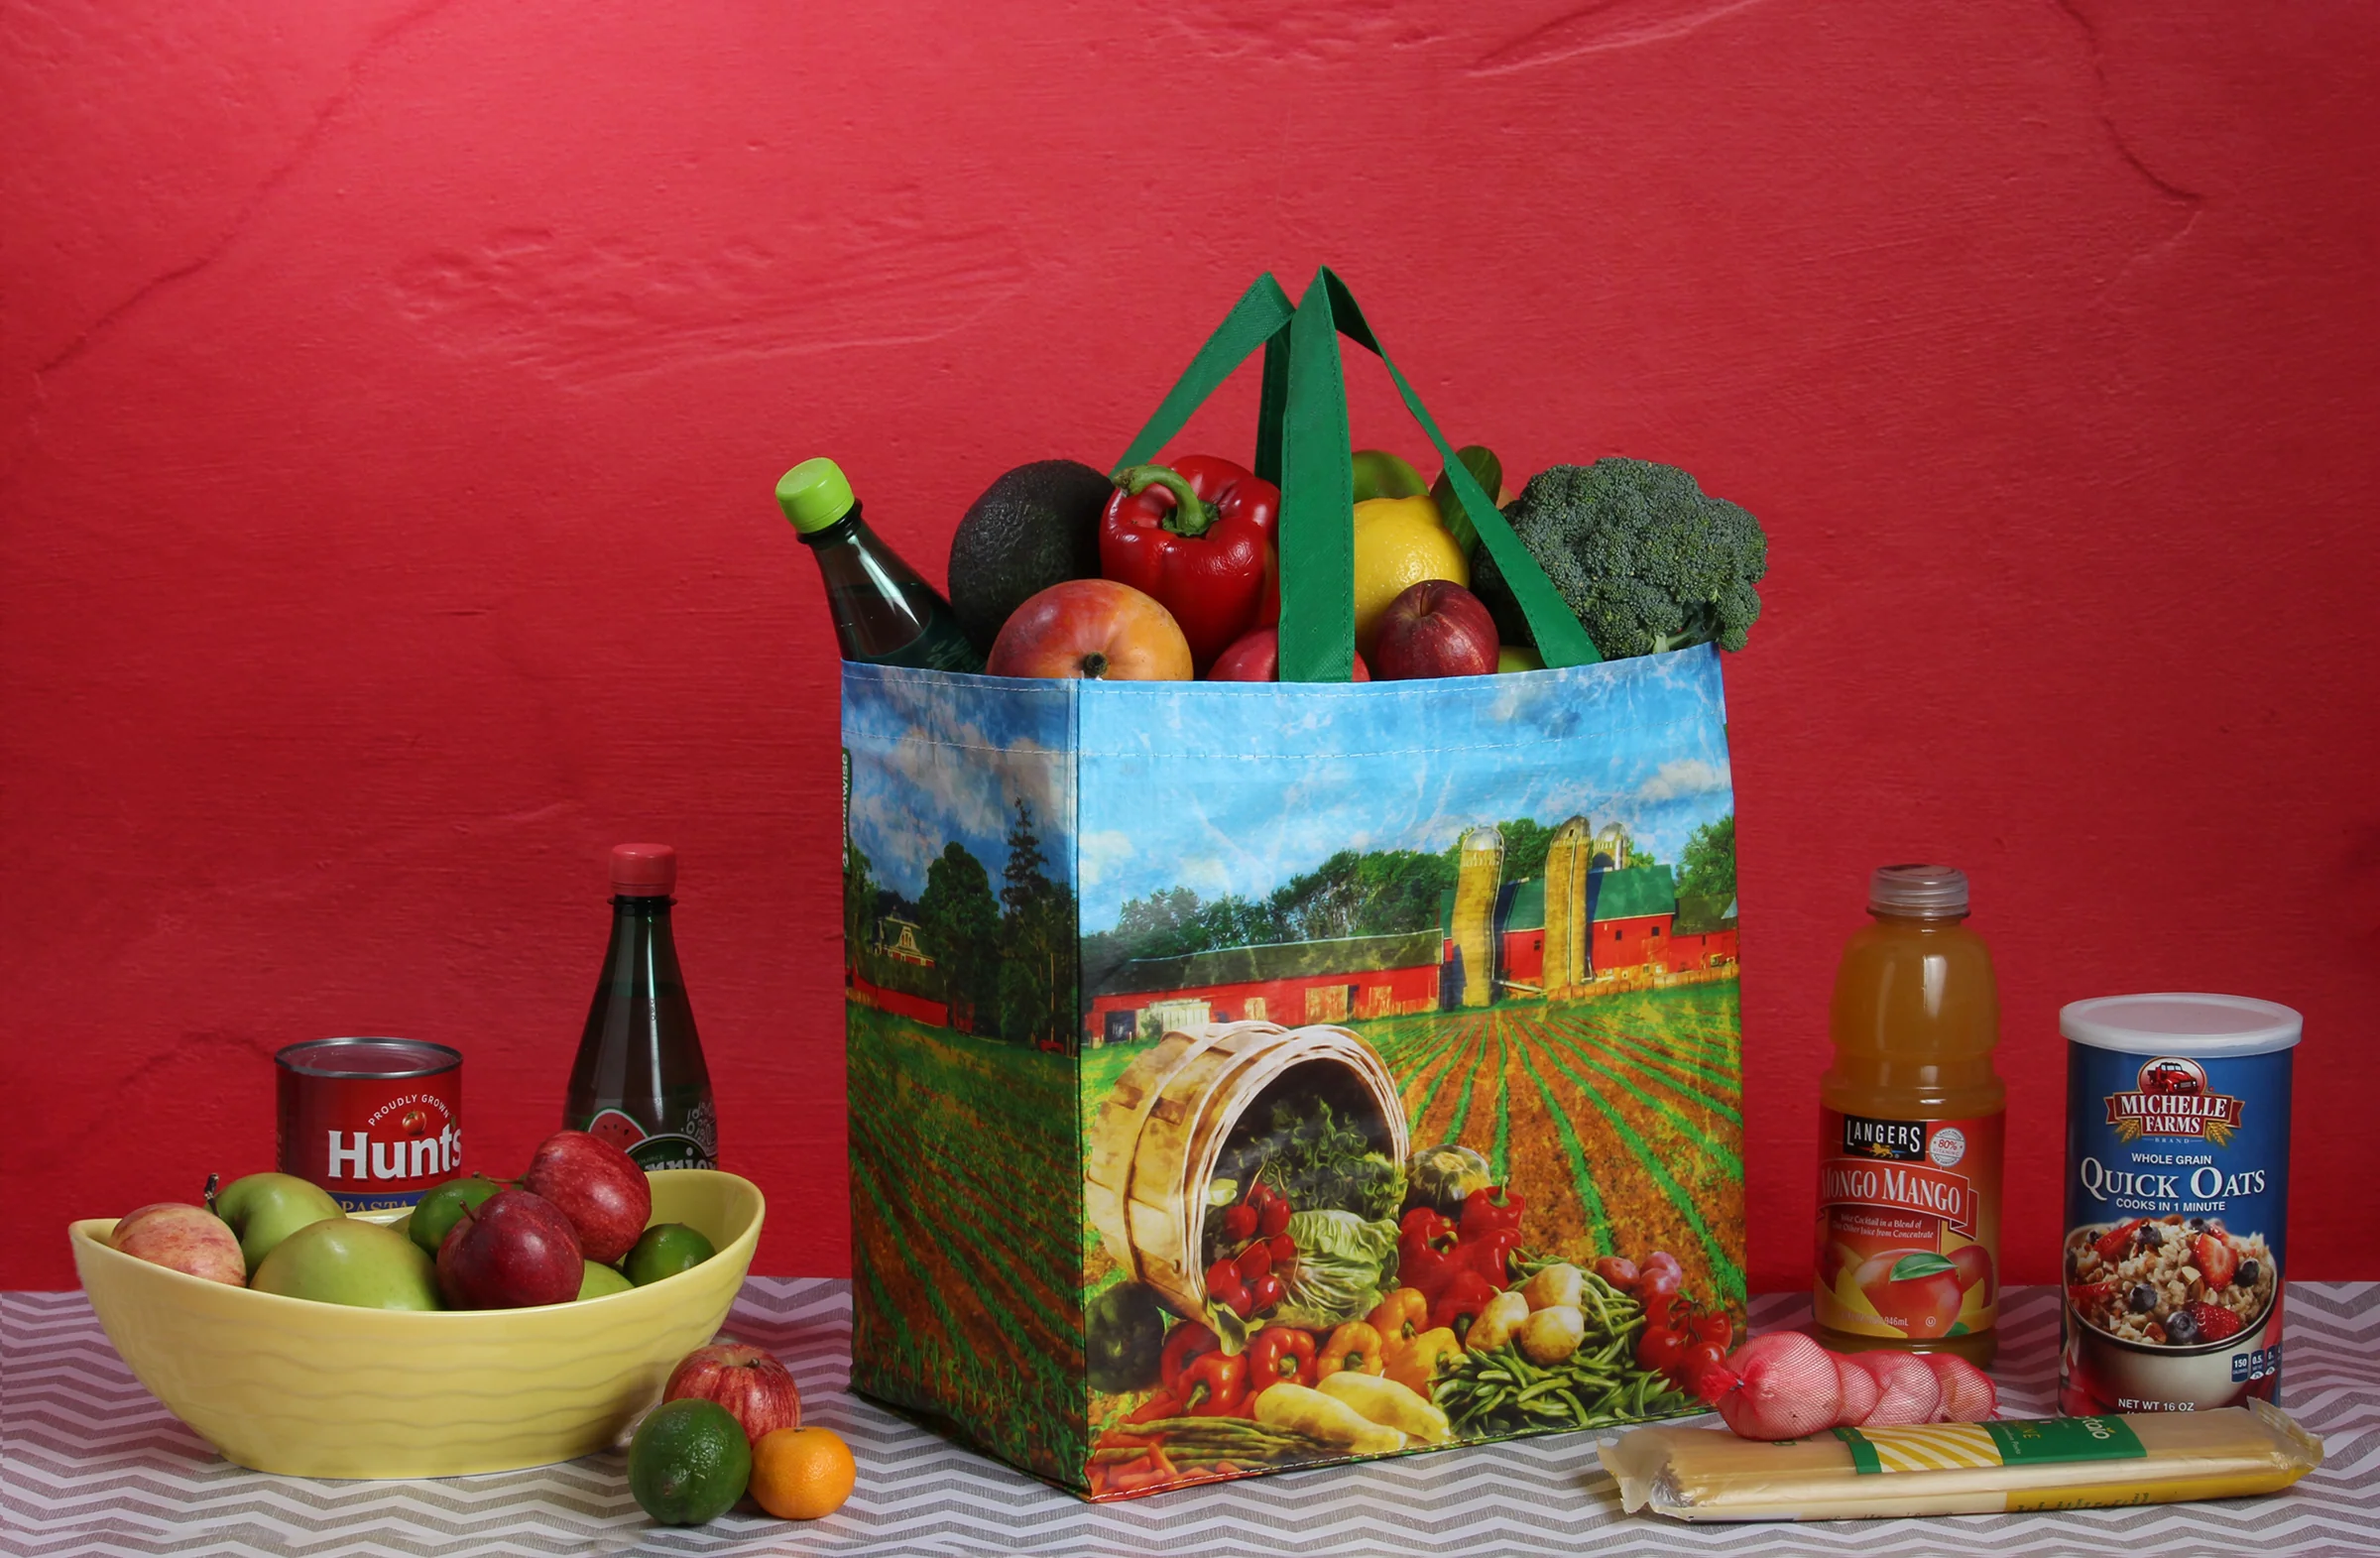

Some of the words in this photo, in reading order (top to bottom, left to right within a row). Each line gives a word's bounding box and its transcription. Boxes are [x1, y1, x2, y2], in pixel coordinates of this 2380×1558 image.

[368, 1094, 417, 1127] PROUDLY
[421, 1094, 449, 1119] GROWN
[2120, 1095, 2227, 1118] MICHELLE
[2145, 1116, 2201, 1134] FARMS
[1846, 1120, 1921, 1153] LANGERS
[1938, 1139, 1958, 1150] 80%
[2131, 1152, 2173, 1164] WHOLE
[2176, 1154, 2212, 1165] GRAIN
[2081, 1156, 2180, 1201] QUICK
[2190, 1166, 2266, 1199] OATS
[1882, 1167, 1961, 1215] MANGO
[2115, 1197, 2156, 1211] COOKS
[2159, 1202, 2171, 1212] IN
[2174, 1202, 2180, 1212] 1
[2183, 1201, 2226, 1212] MINUTE
[1854, 1215, 1879, 1227] Cocktail
[1894, 1220, 1914, 1229] Blend
[1915, 1220, 1922, 1230] of
[1876, 1228, 1891, 1238] from
[1892, 1230, 1934, 1239] Concentrate
[1884, 1316, 1909, 1327] 946mL
[2234, 1359, 2247, 1368] 150
[2118, 1398, 2140, 1408] NET
[2142, 1401, 2160, 1410] WT
[2163, 1402, 2176, 1411] 16
[2178, 1402, 2195, 1411] OZ
